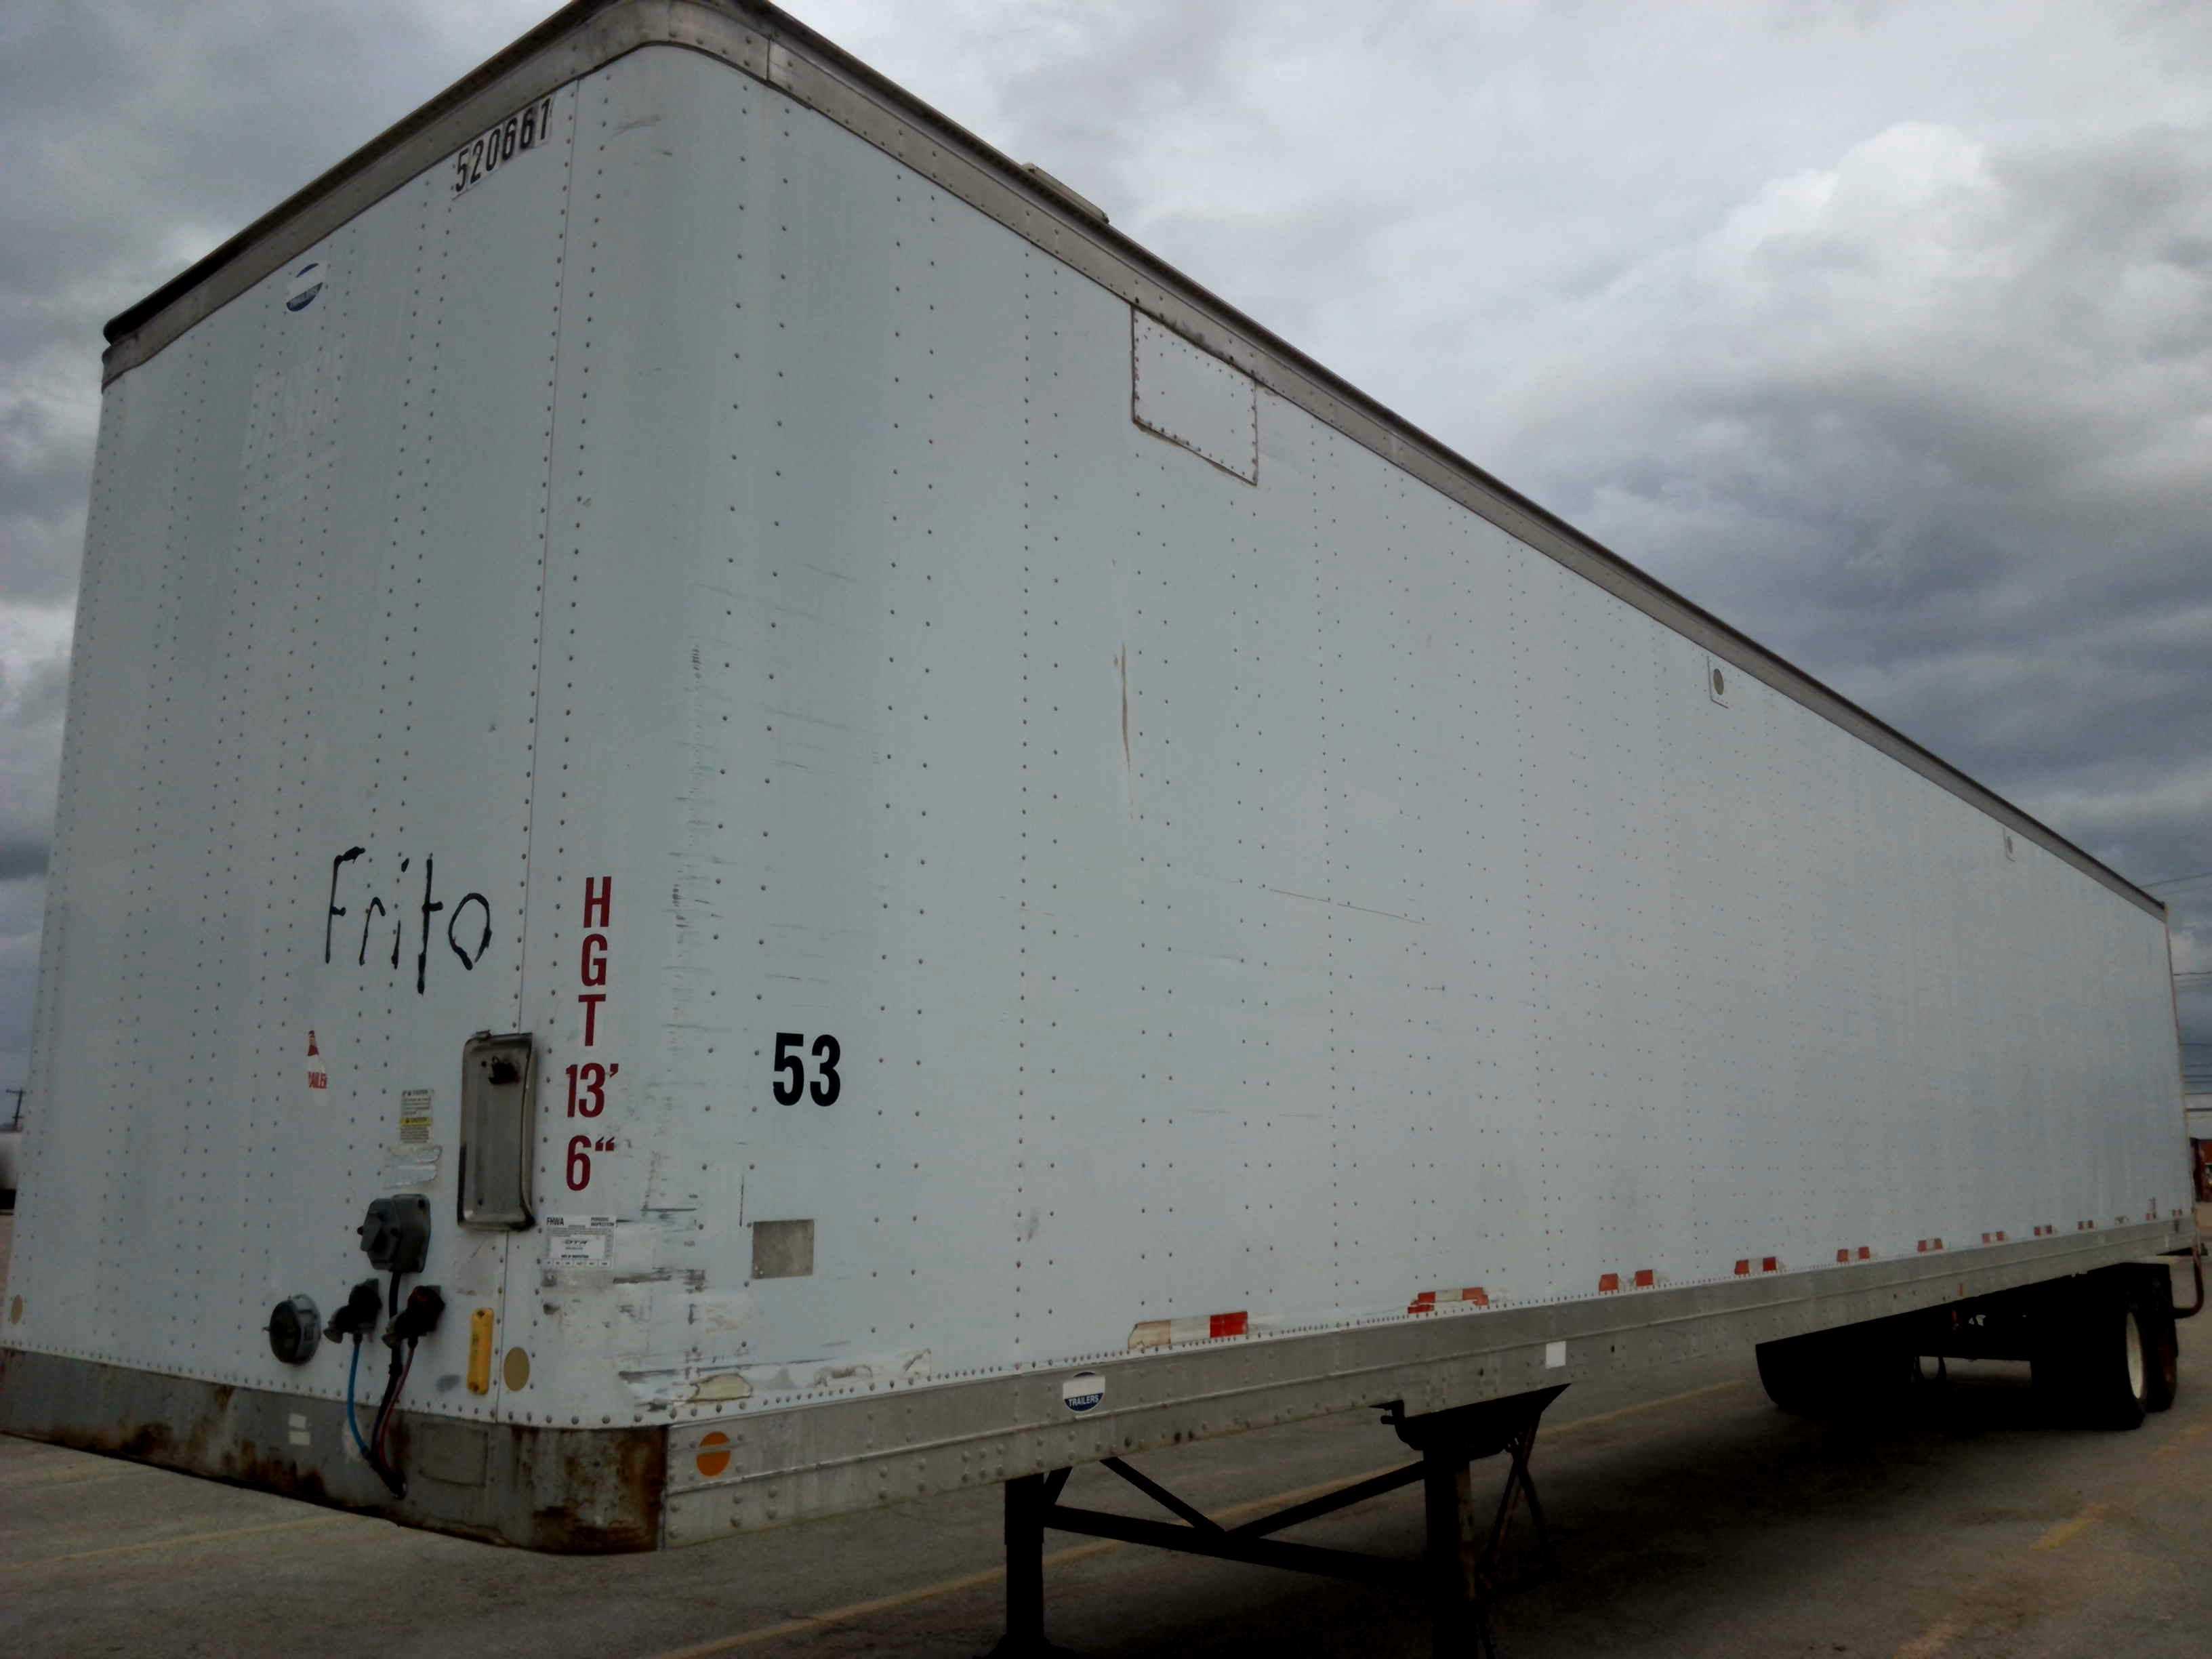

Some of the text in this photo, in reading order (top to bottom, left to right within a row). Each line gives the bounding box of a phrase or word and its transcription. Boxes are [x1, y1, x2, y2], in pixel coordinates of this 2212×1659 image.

[455, 98, 551, 192] 520661
[325, 846, 492, 995] Frito
[565, 1063, 619, 1118] 13'
[773, 1032, 841, 1107] 53
[1069, 1395, 1099, 1406] TRAILERS
